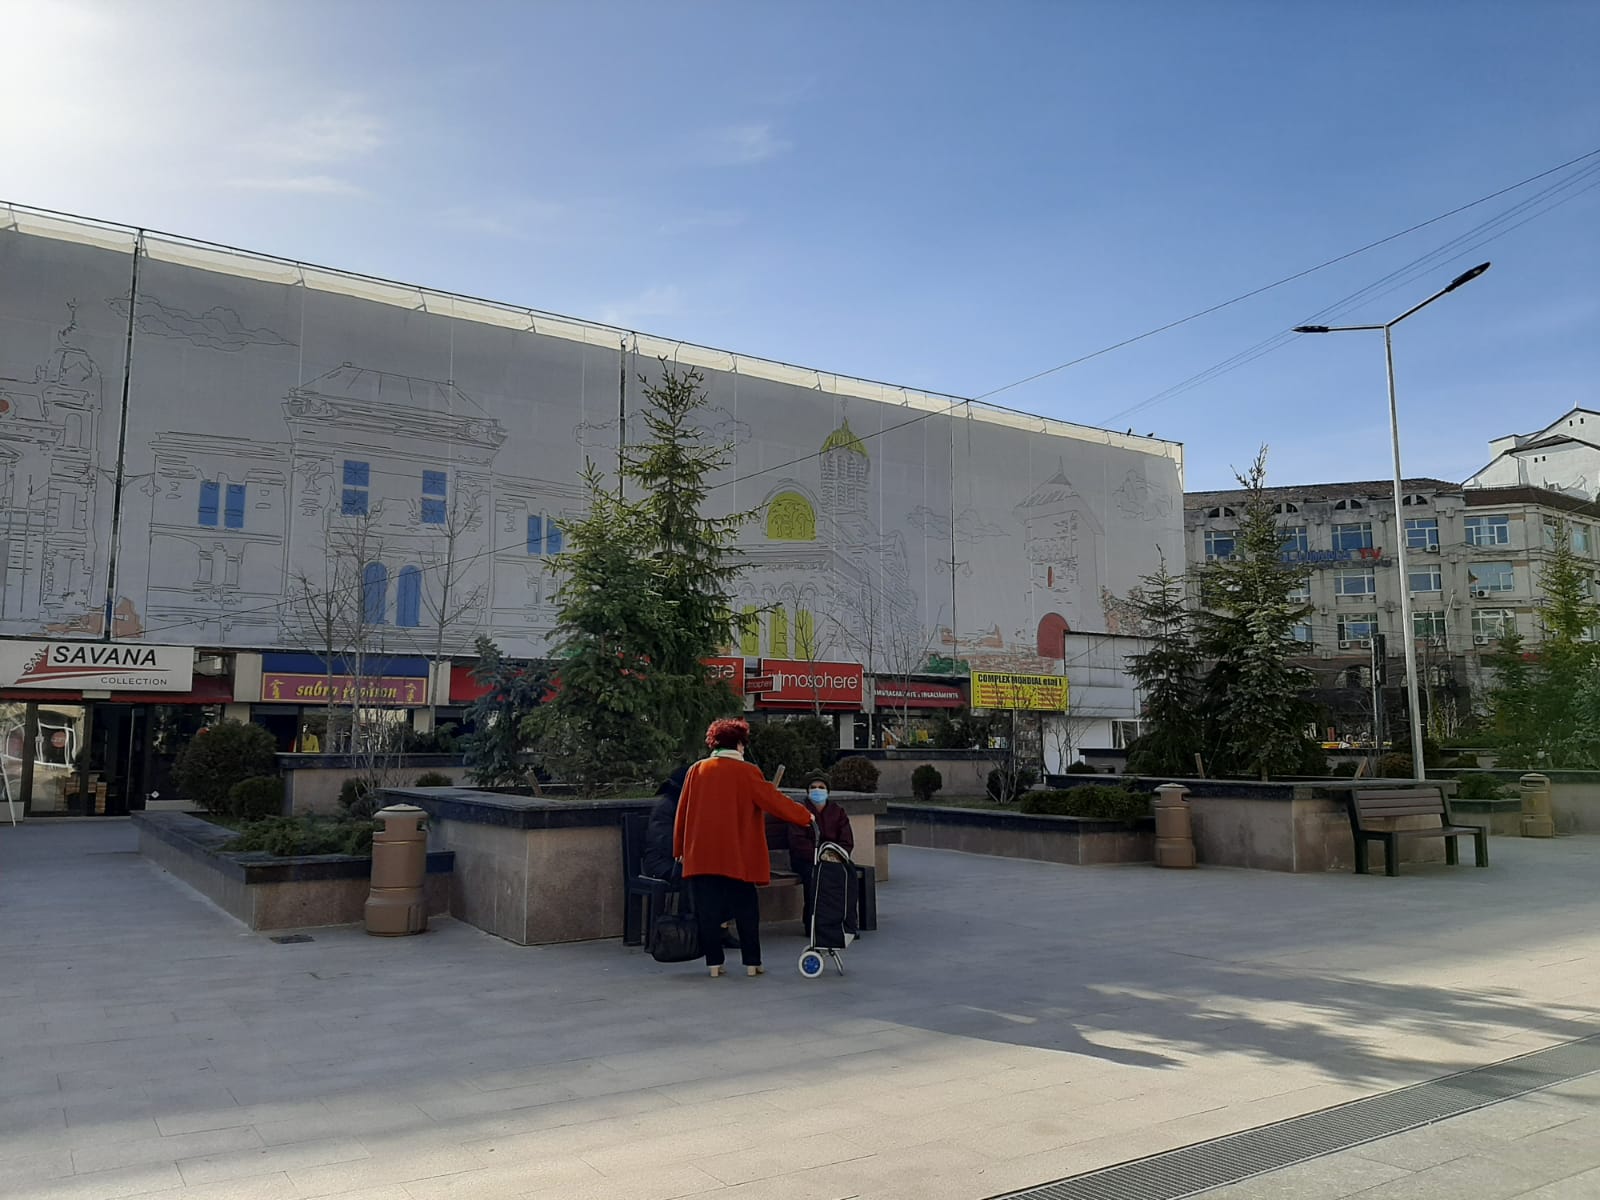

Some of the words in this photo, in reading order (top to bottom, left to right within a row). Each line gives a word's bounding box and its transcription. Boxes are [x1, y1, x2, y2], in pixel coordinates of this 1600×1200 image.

[53, 646, 157, 666] SAVANA
[100, 677, 168, 686] COLLECTION
[767, 670, 858, 689] mosphere
[978, 674, 1010, 684] COMPLEX
[1011, 676, 1041, 686] MONDIAL
